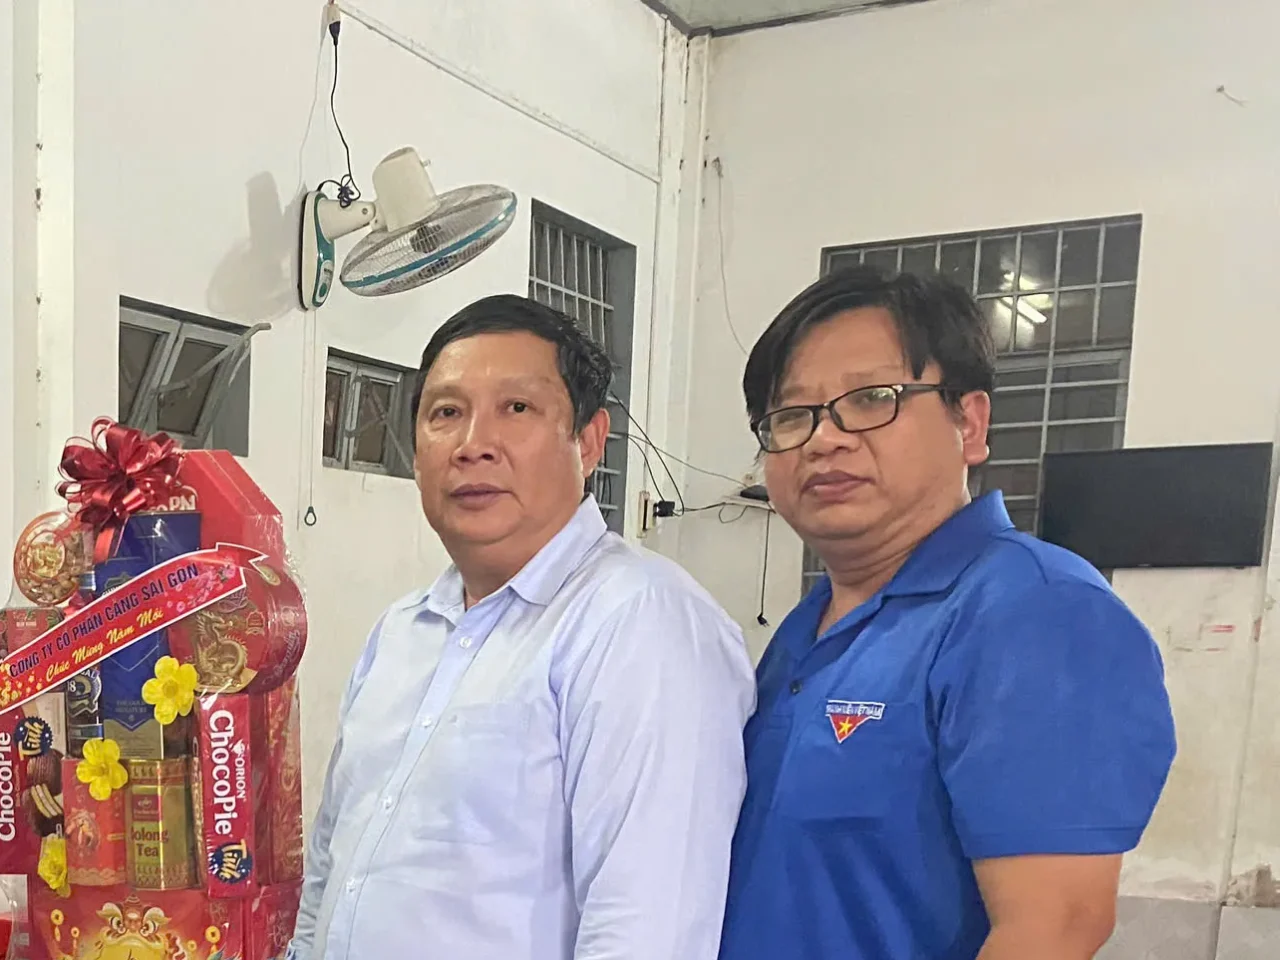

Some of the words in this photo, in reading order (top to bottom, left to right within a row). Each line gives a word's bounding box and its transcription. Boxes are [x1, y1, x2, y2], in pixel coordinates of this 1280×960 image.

[209, 709, 238, 836] ChocoPie
[234, 757, 247, 799] ORION
[136, 843, 159, 857] Tea
